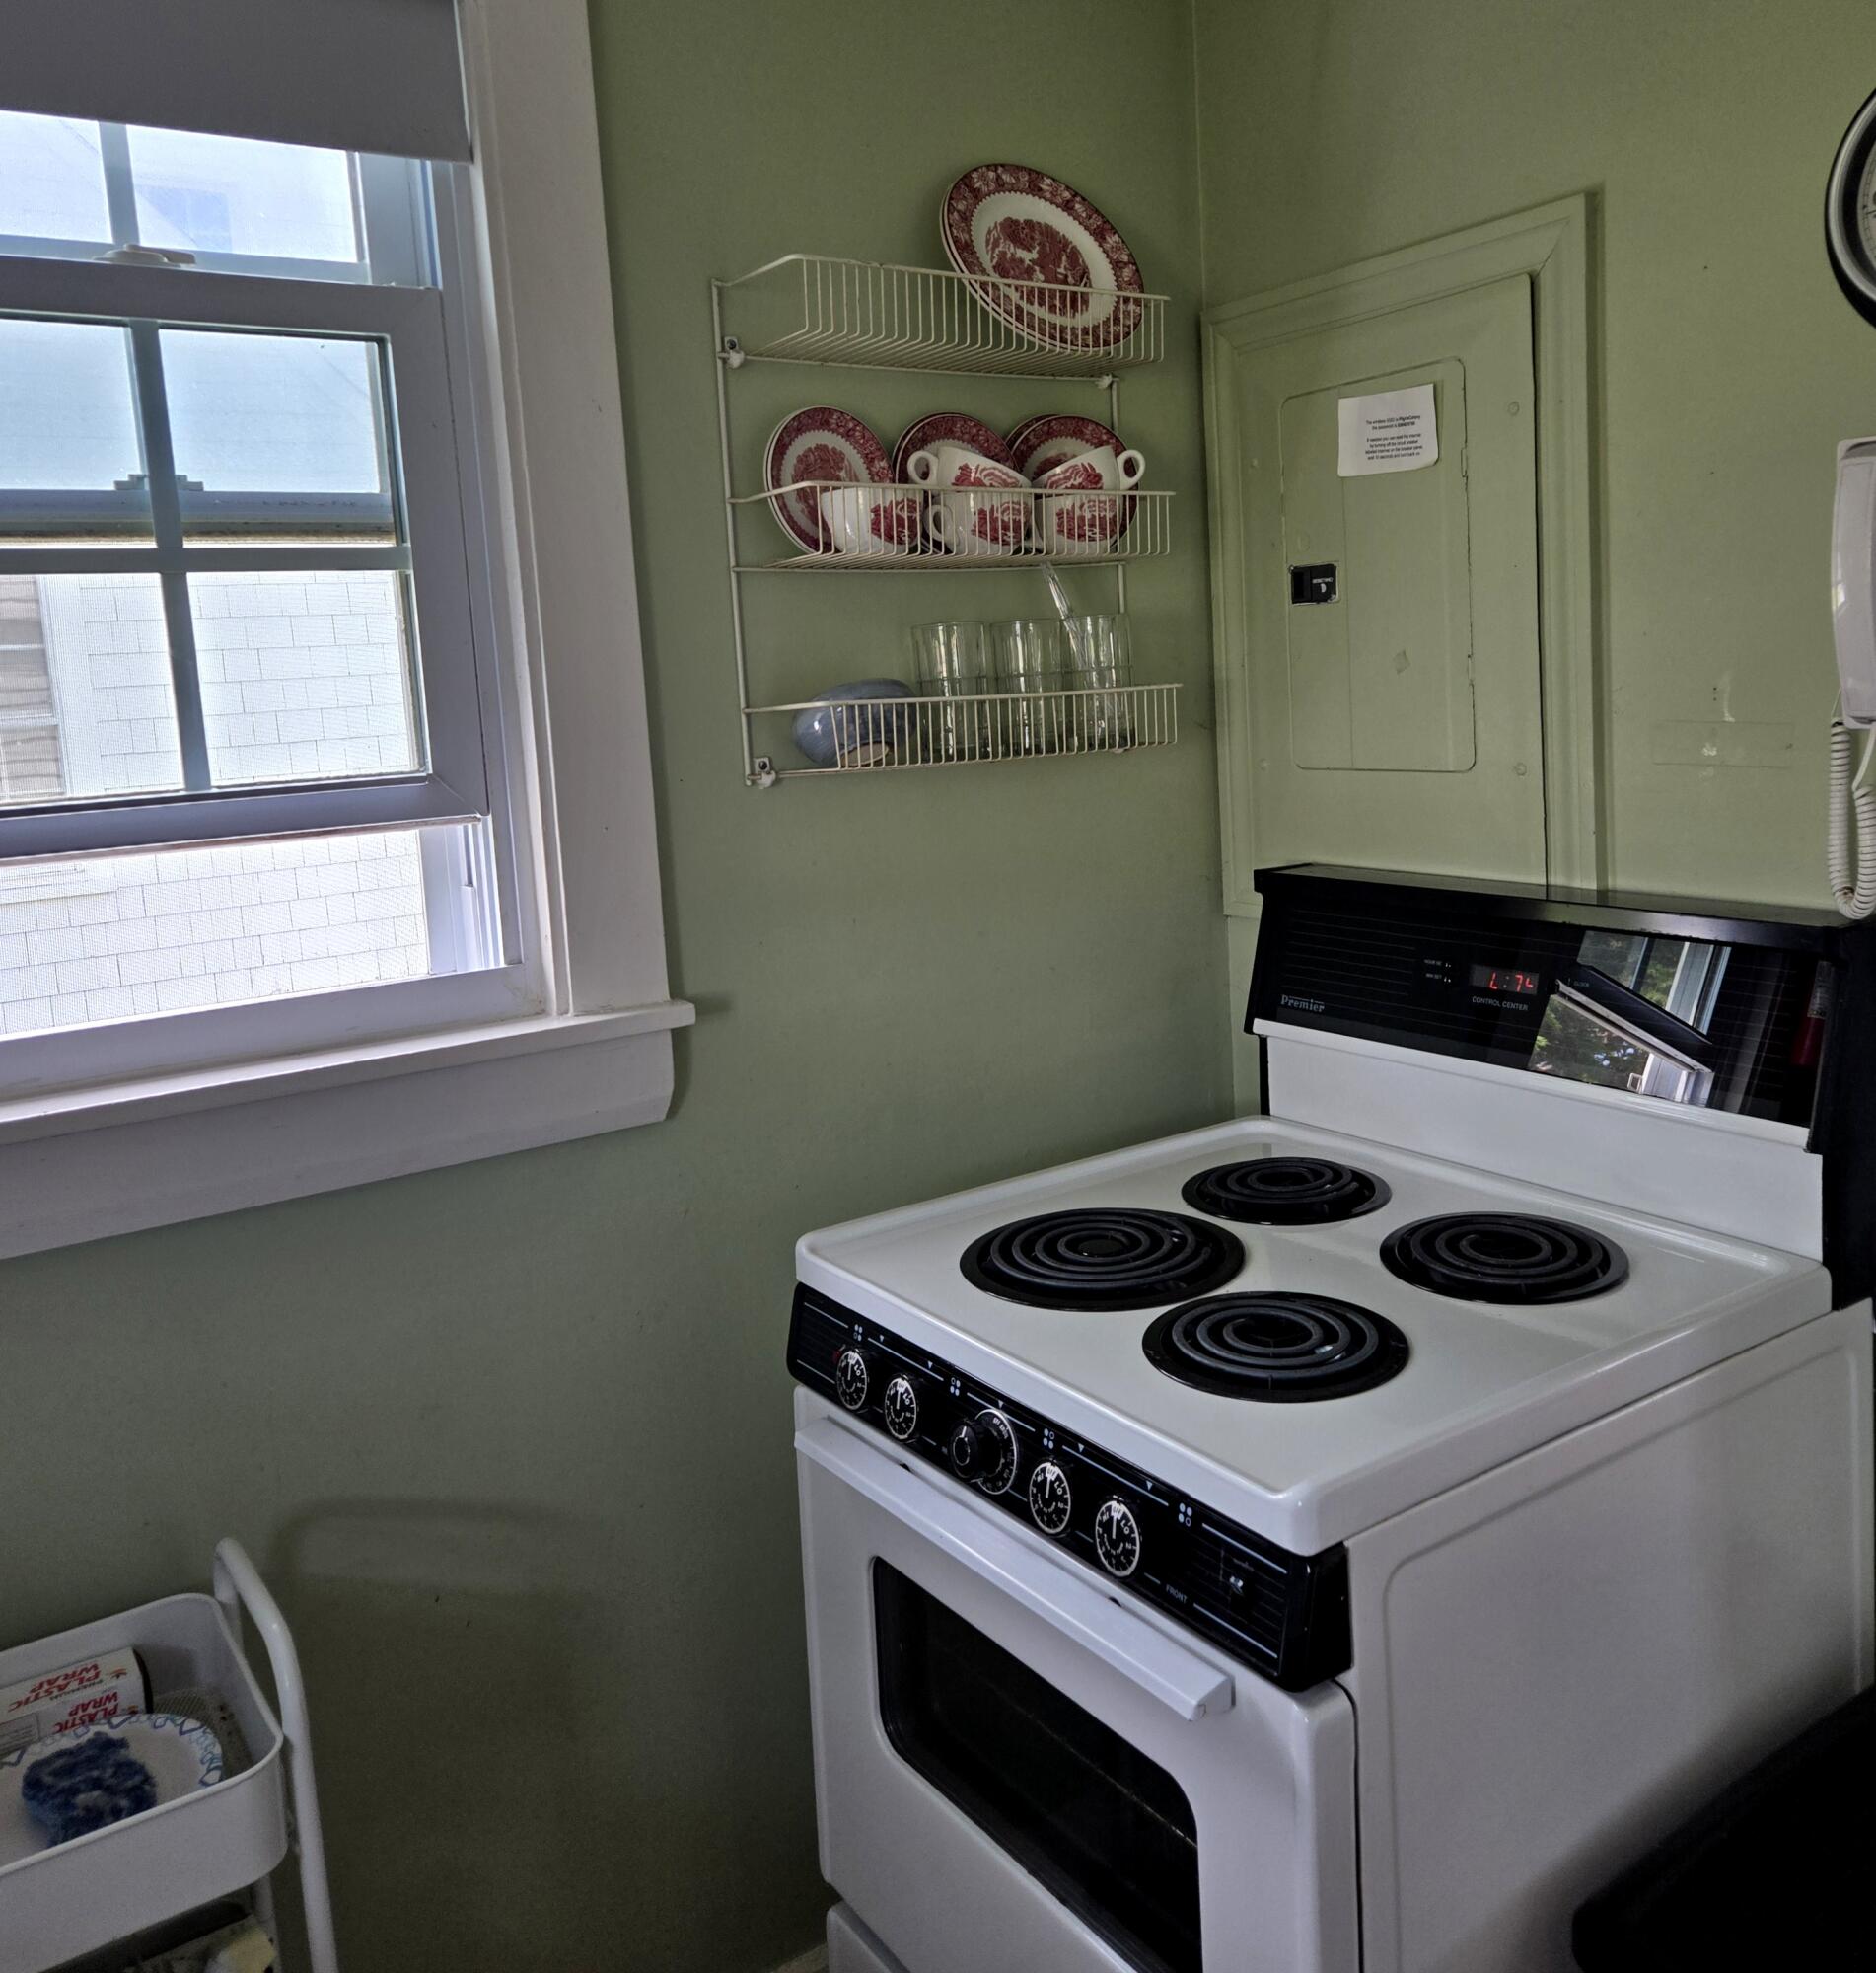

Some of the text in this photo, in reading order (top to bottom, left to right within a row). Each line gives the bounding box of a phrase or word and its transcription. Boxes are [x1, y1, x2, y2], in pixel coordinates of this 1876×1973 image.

[1281, 994, 1325, 1012] Premier
[1472, 996, 1529, 1010] CONTROL CENTER
[1053, 1481, 1063, 1495] LO
[1119, 1520, 1130, 1535] LO
[1166, 1583, 1187, 1604] FRONT
[29, 1663, 100, 1694] WRAP
[8, 1670, 101, 1713] PLASTIC
[68, 1691, 118, 1717] WRAP
[52, 1703, 118, 1735] PLASTIC
